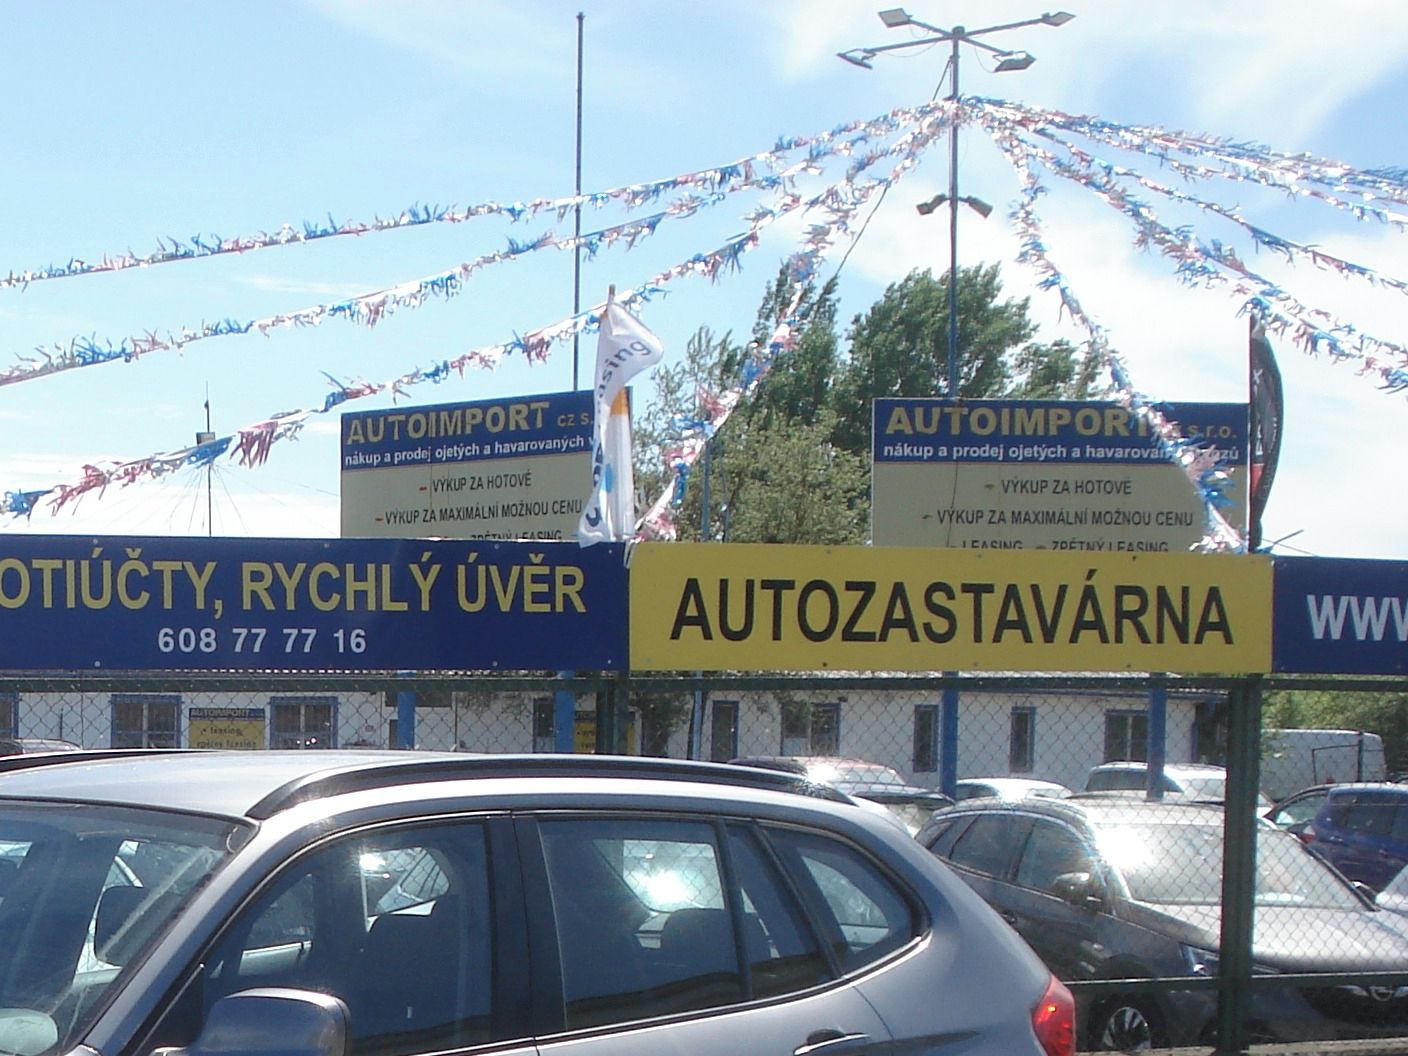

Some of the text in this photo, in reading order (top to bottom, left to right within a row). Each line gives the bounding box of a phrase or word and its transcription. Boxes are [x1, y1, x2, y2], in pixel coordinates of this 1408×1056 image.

[346, 401, 551, 446] AUTOIMPORT
[345, 451, 382, 467] nákup
[384, 452, 392, 463] a
[394, 446, 433, 465] prodej
[435, 442, 481, 461] ojetých
[483, 443, 491, 455] a
[494, 434, 584, 454] havarovaných
[883, 443, 934, 460] nákup
[938, 447, 948, 458] a
[953, 444, 1004, 461] prodej
[1008, 444, 1067, 461] ojetých
[1071, 447, 1081, 459] a
[432, 475, 467, 493] VÝKUP
[469, 476, 485, 491] ZA
[1001, 478, 1049, 494] VÝKUP
[1052, 480, 1071, 494] ZA
[385, 507, 420, 525] VÝKUP
[422, 509, 438, 523] ZA
[552, 499, 583, 515] CENU
[937, 506, 1194, 527] VÝKUP ZA MAXIMÁLNÍ MOŽNOU CENU
[241, 551, 442, 613] RYCHLÝ
[456, 553, 588, 614] ÚVĚR
[669, 567, 1236, 646] AUTOZASTAVÁRNA
[157, 627, 368, 654] 608 77 77 16
